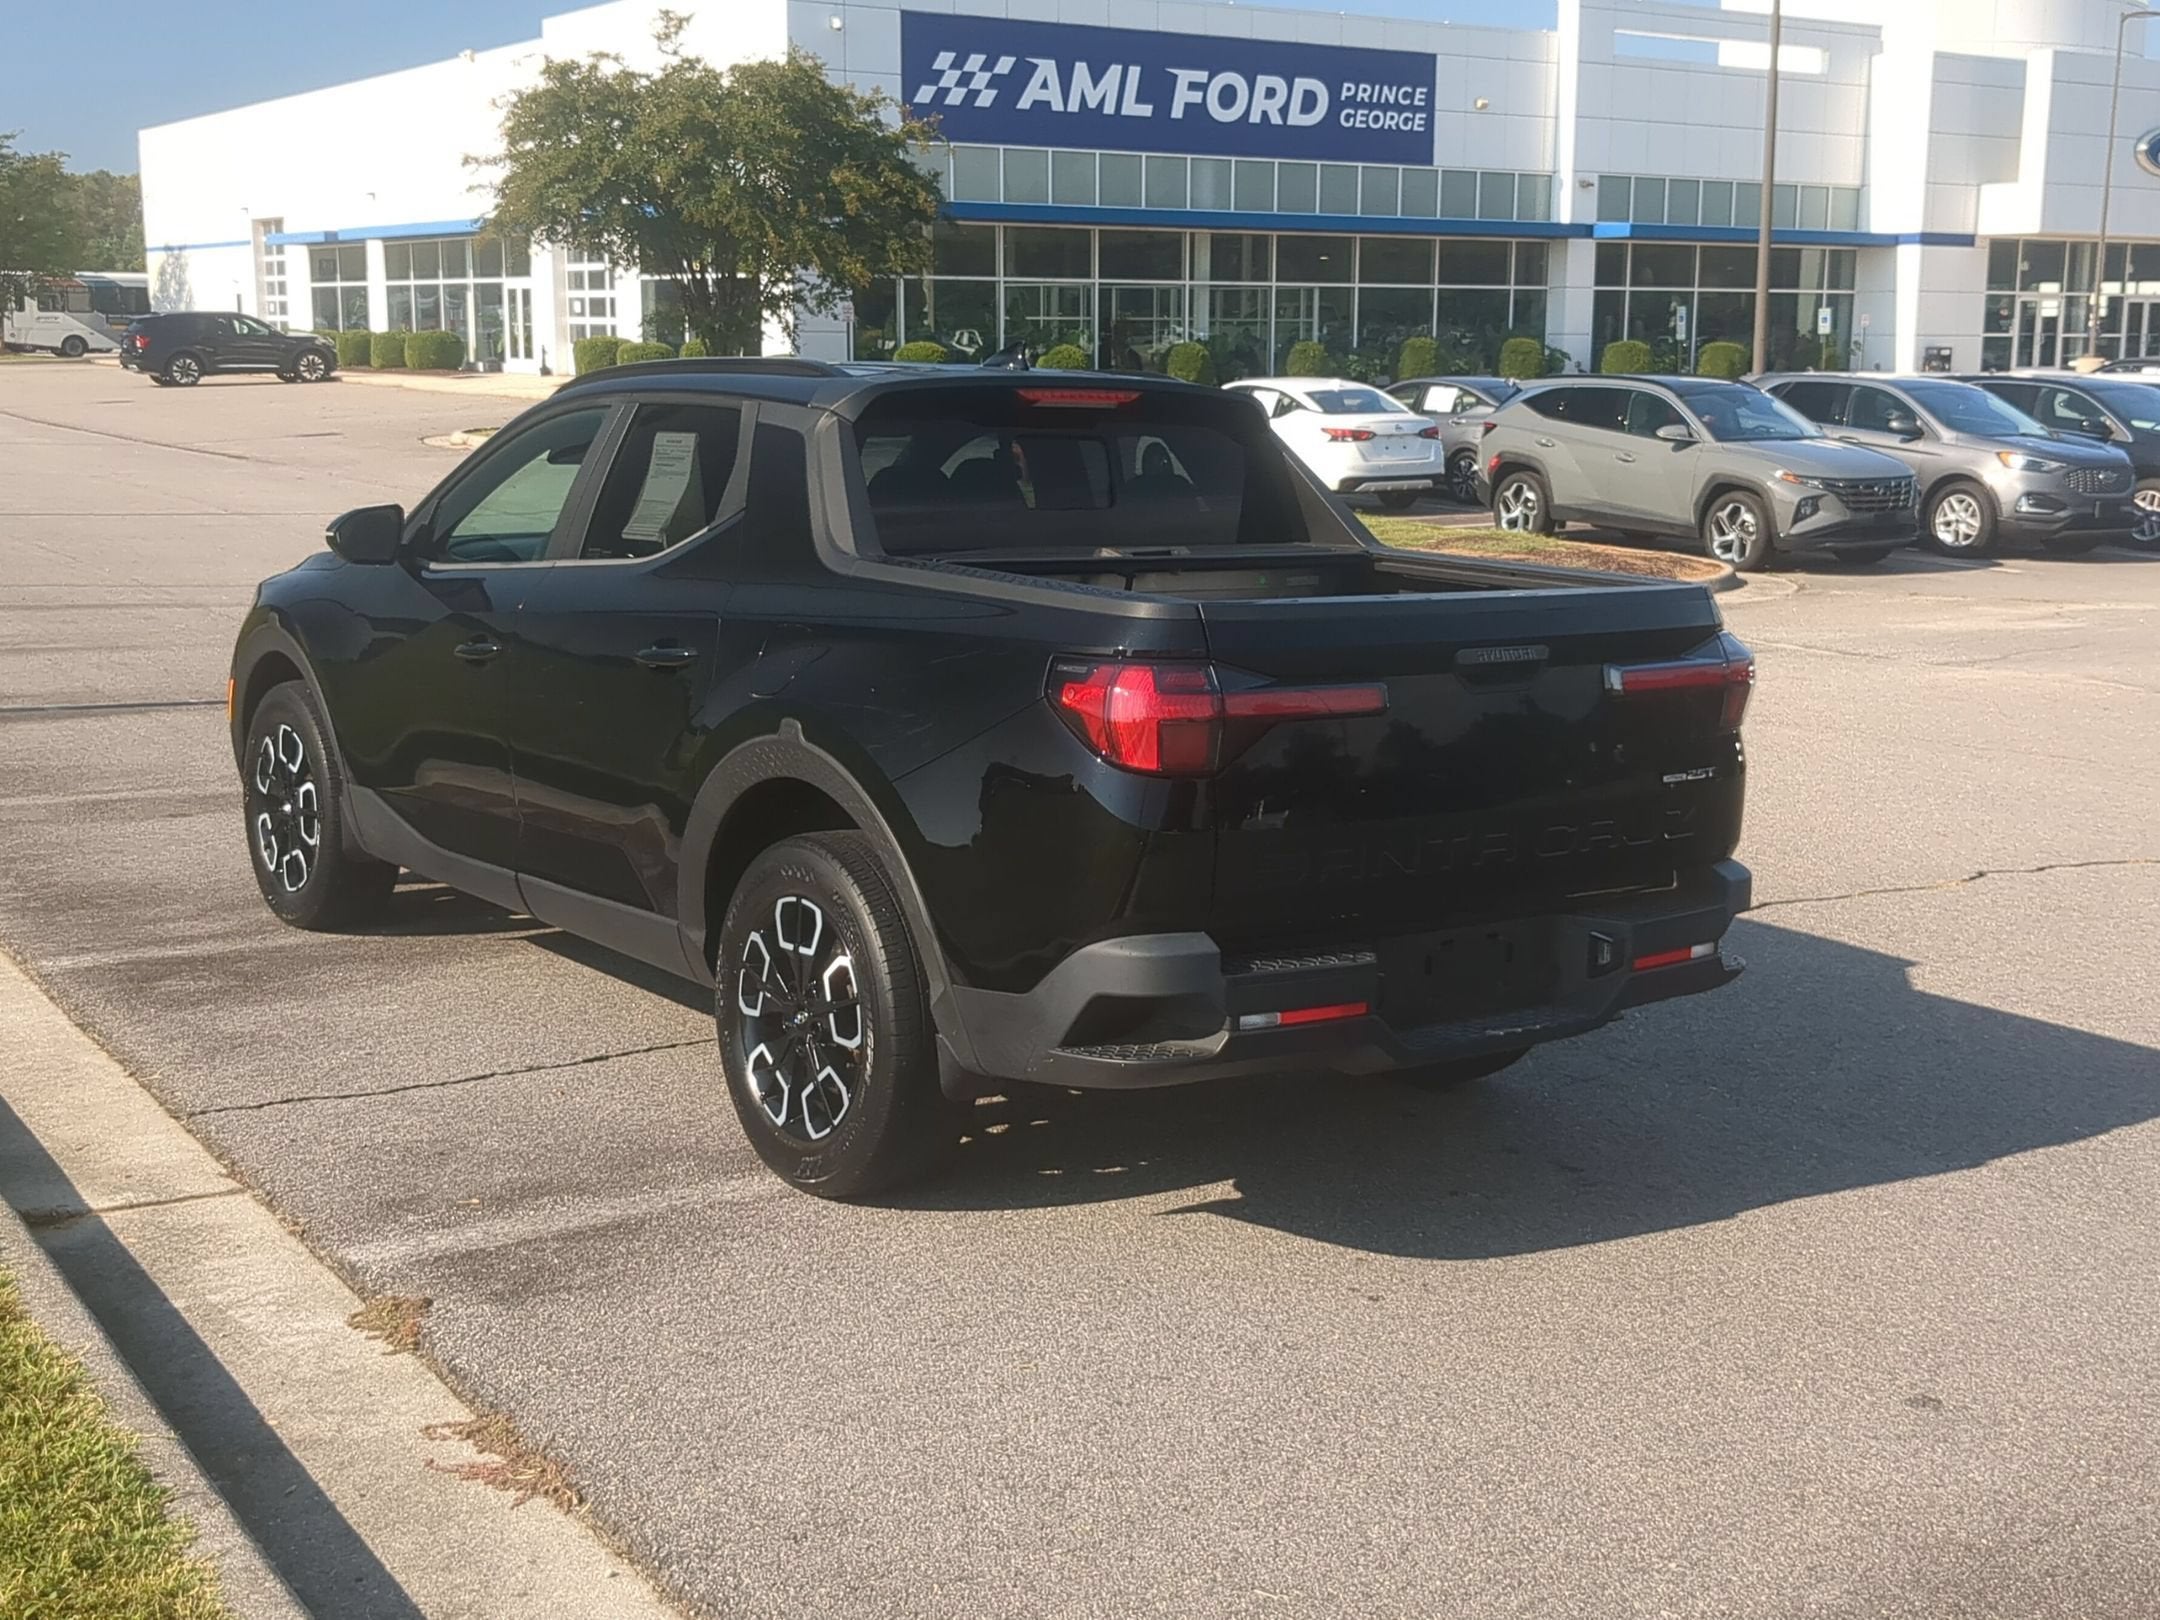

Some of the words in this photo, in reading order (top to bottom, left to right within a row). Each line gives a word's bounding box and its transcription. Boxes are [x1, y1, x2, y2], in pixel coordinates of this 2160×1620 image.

[1016, 57, 1153, 118] AML
[1165, 67, 1329, 126] FORD
[1340, 82, 1428, 107] PRINCE
[1339, 108, 1427, 132] GEORGE
